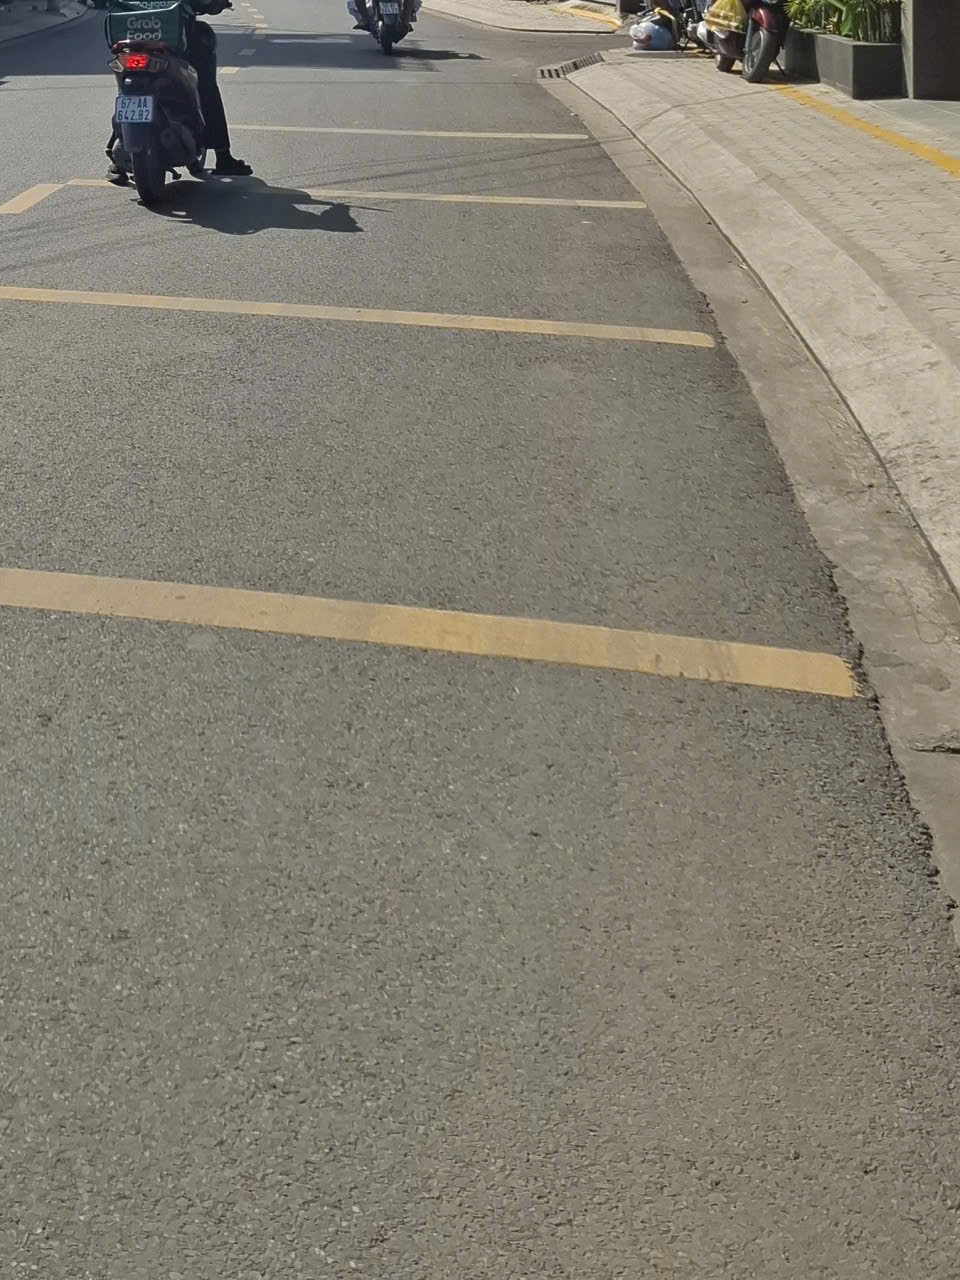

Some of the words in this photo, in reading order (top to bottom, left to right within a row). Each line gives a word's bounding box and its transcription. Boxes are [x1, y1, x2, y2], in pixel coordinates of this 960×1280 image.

[127, 16, 161, 29] Grab
[127, 29, 161, 40] Food
[121, 97, 148, 109] 67-AA
[117, 109, 150, 121] 642.82
